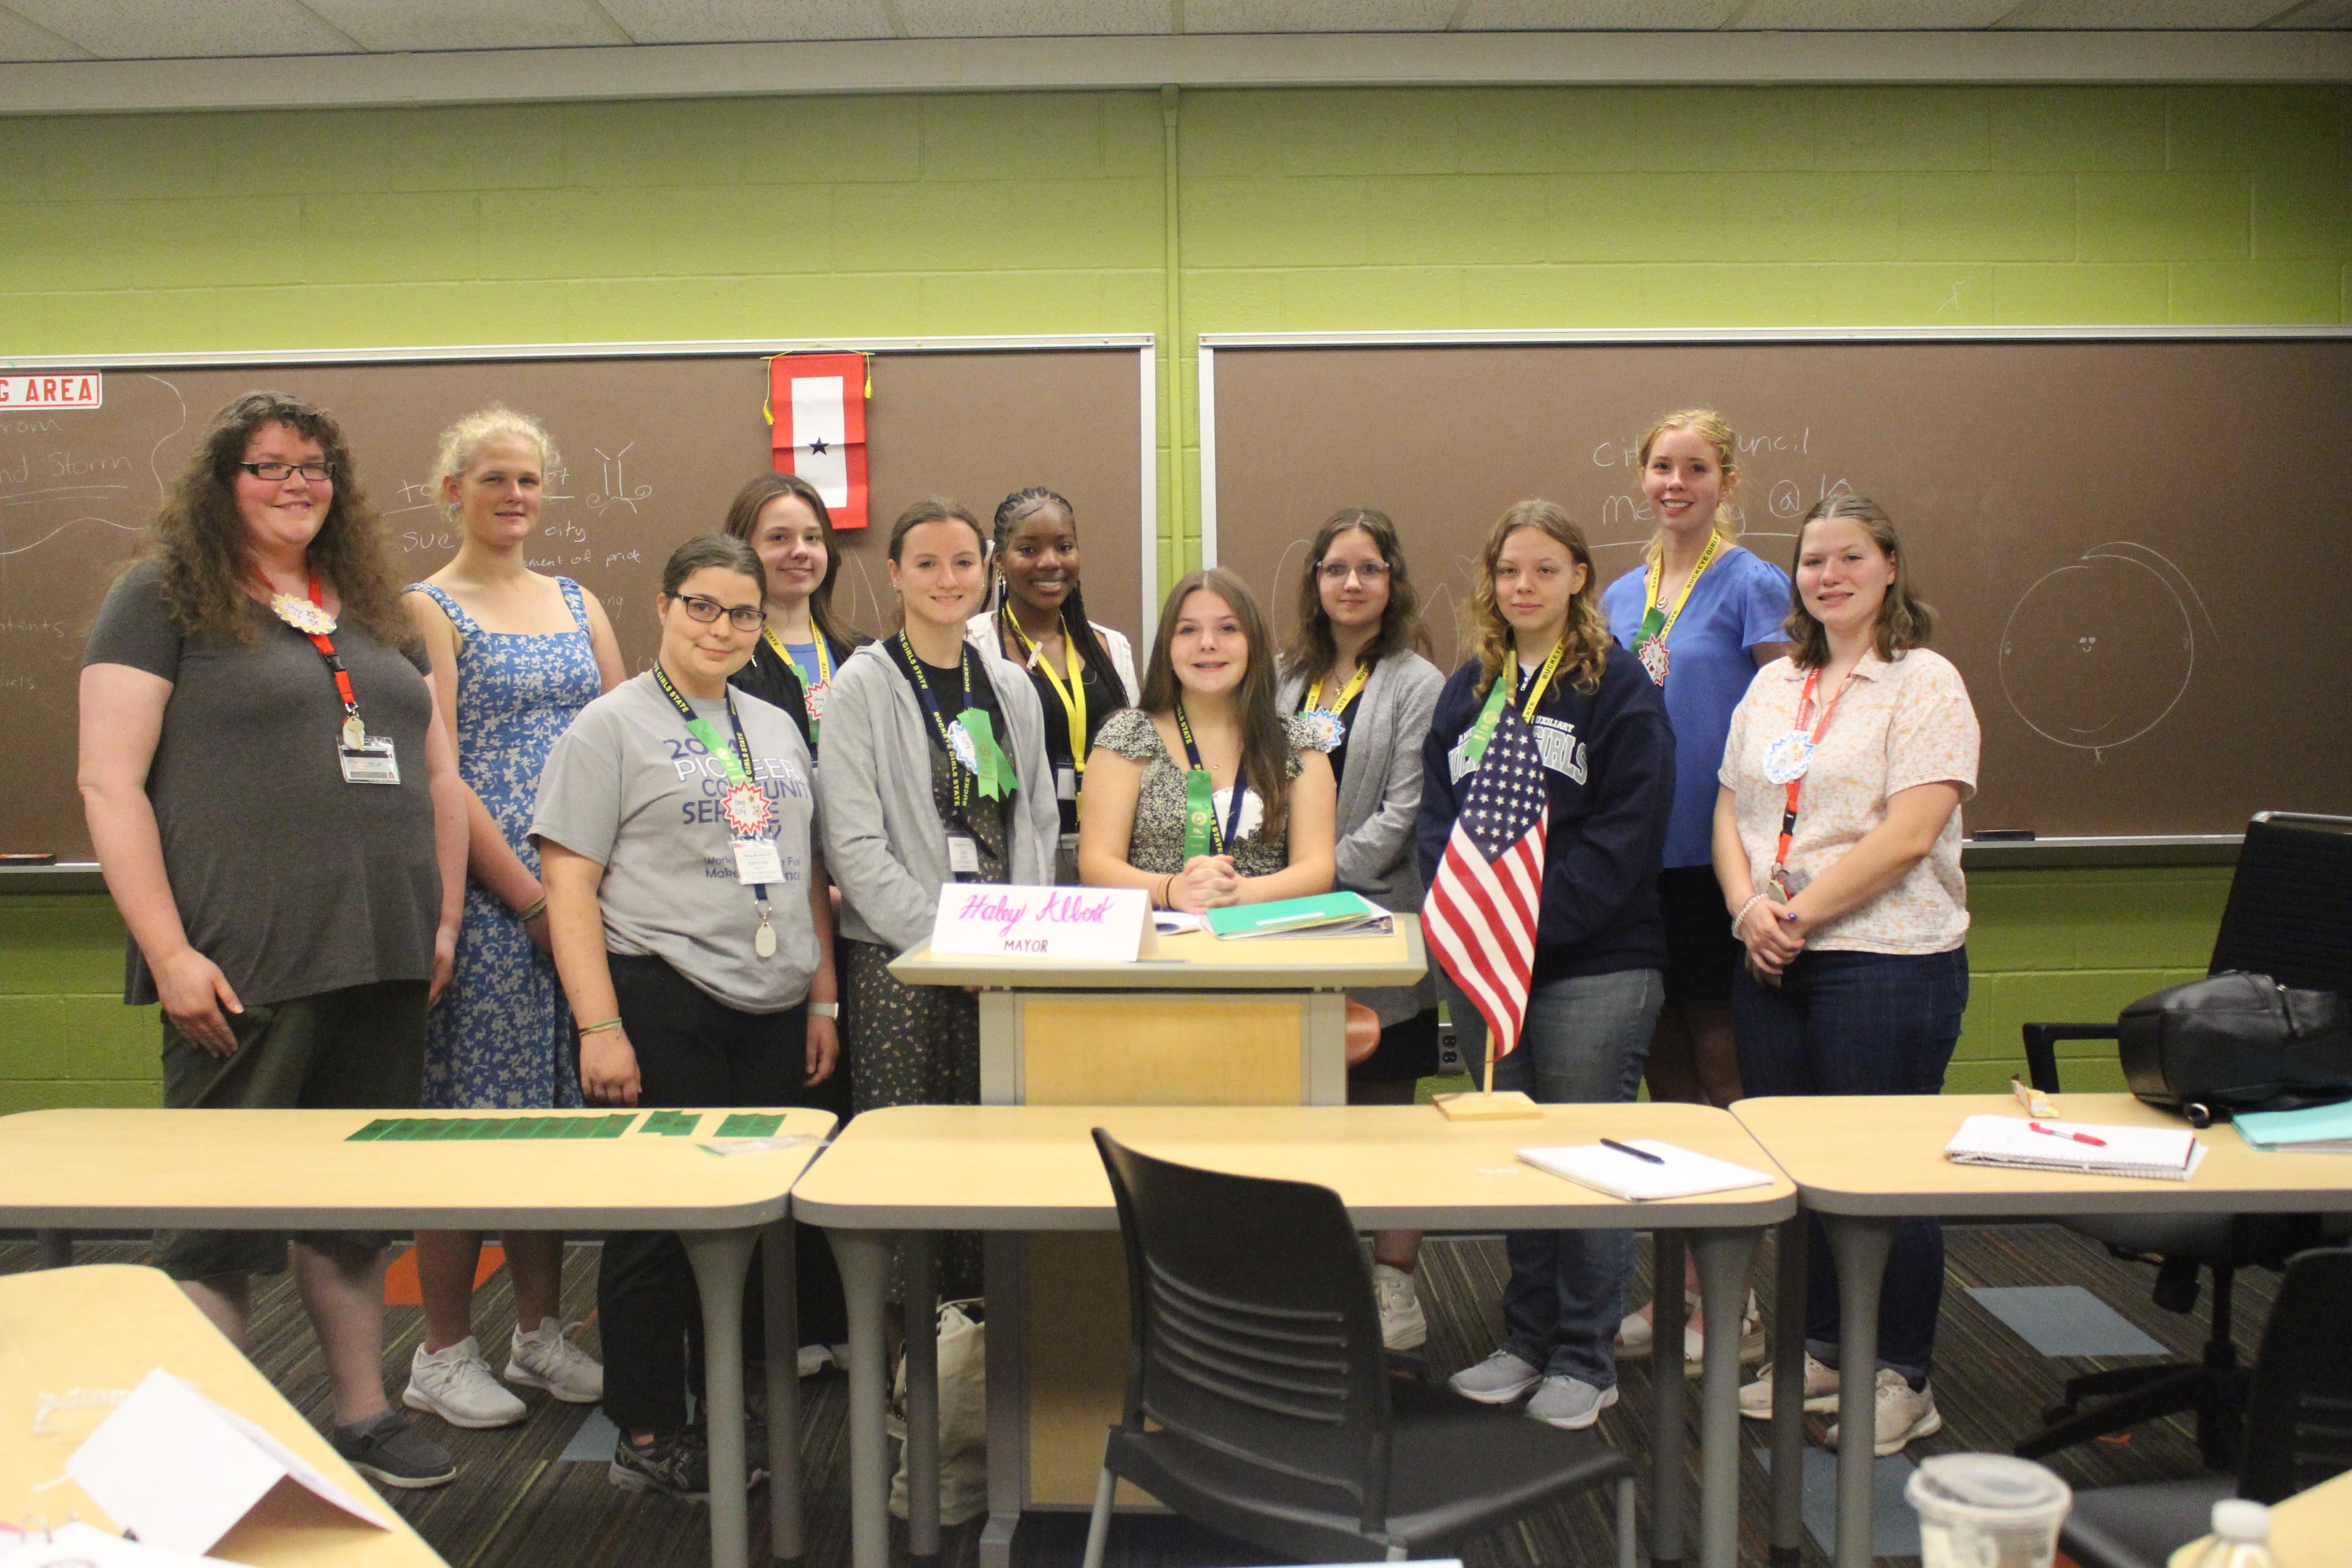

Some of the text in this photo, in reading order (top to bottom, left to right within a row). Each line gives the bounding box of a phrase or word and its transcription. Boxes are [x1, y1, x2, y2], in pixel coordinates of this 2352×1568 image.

[26, 379, 92, 401] AREA
[0, 419, 64, 433] rom
[1738, 427, 1810, 457] uncil
[48, 451, 133, 477] Storm
[545, 520, 586, 543] city
[523, 556, 564, 568] ement
[571, 549, 591, 565] of
[1686, 555, 1709, 589] BUCKEYE
[902, 642, 917, 665] GIRLS
[913, 664, 929, 690] STATE
[1542, 645, 1564, 679] BUCKEYE
[657, 671, 690, 713] GIRLS STATE
[1335, 697, 1348, 713] TATE
[1523, 701, 1535, 721] TATE
[1795, 698, 1807, 729] BUCKEY
[933, 712, 952, 749] BUCKEYE
[949, 751, 959, 777] GIRLS
[1181, 722, 1193, 745] STATE
[736, 731, 753, 776] GIRLS STATE
[1532, 725, 1588, 786] GIRLS
[674, 758, 799, 782] PIOEER
[962, 771, 971, 807] BUCKEY
[1212, 826, 1224, 853] STATE
[959, 894, 1028, 938] Haley
[1004, 939, 1049, 954] MAYOR
